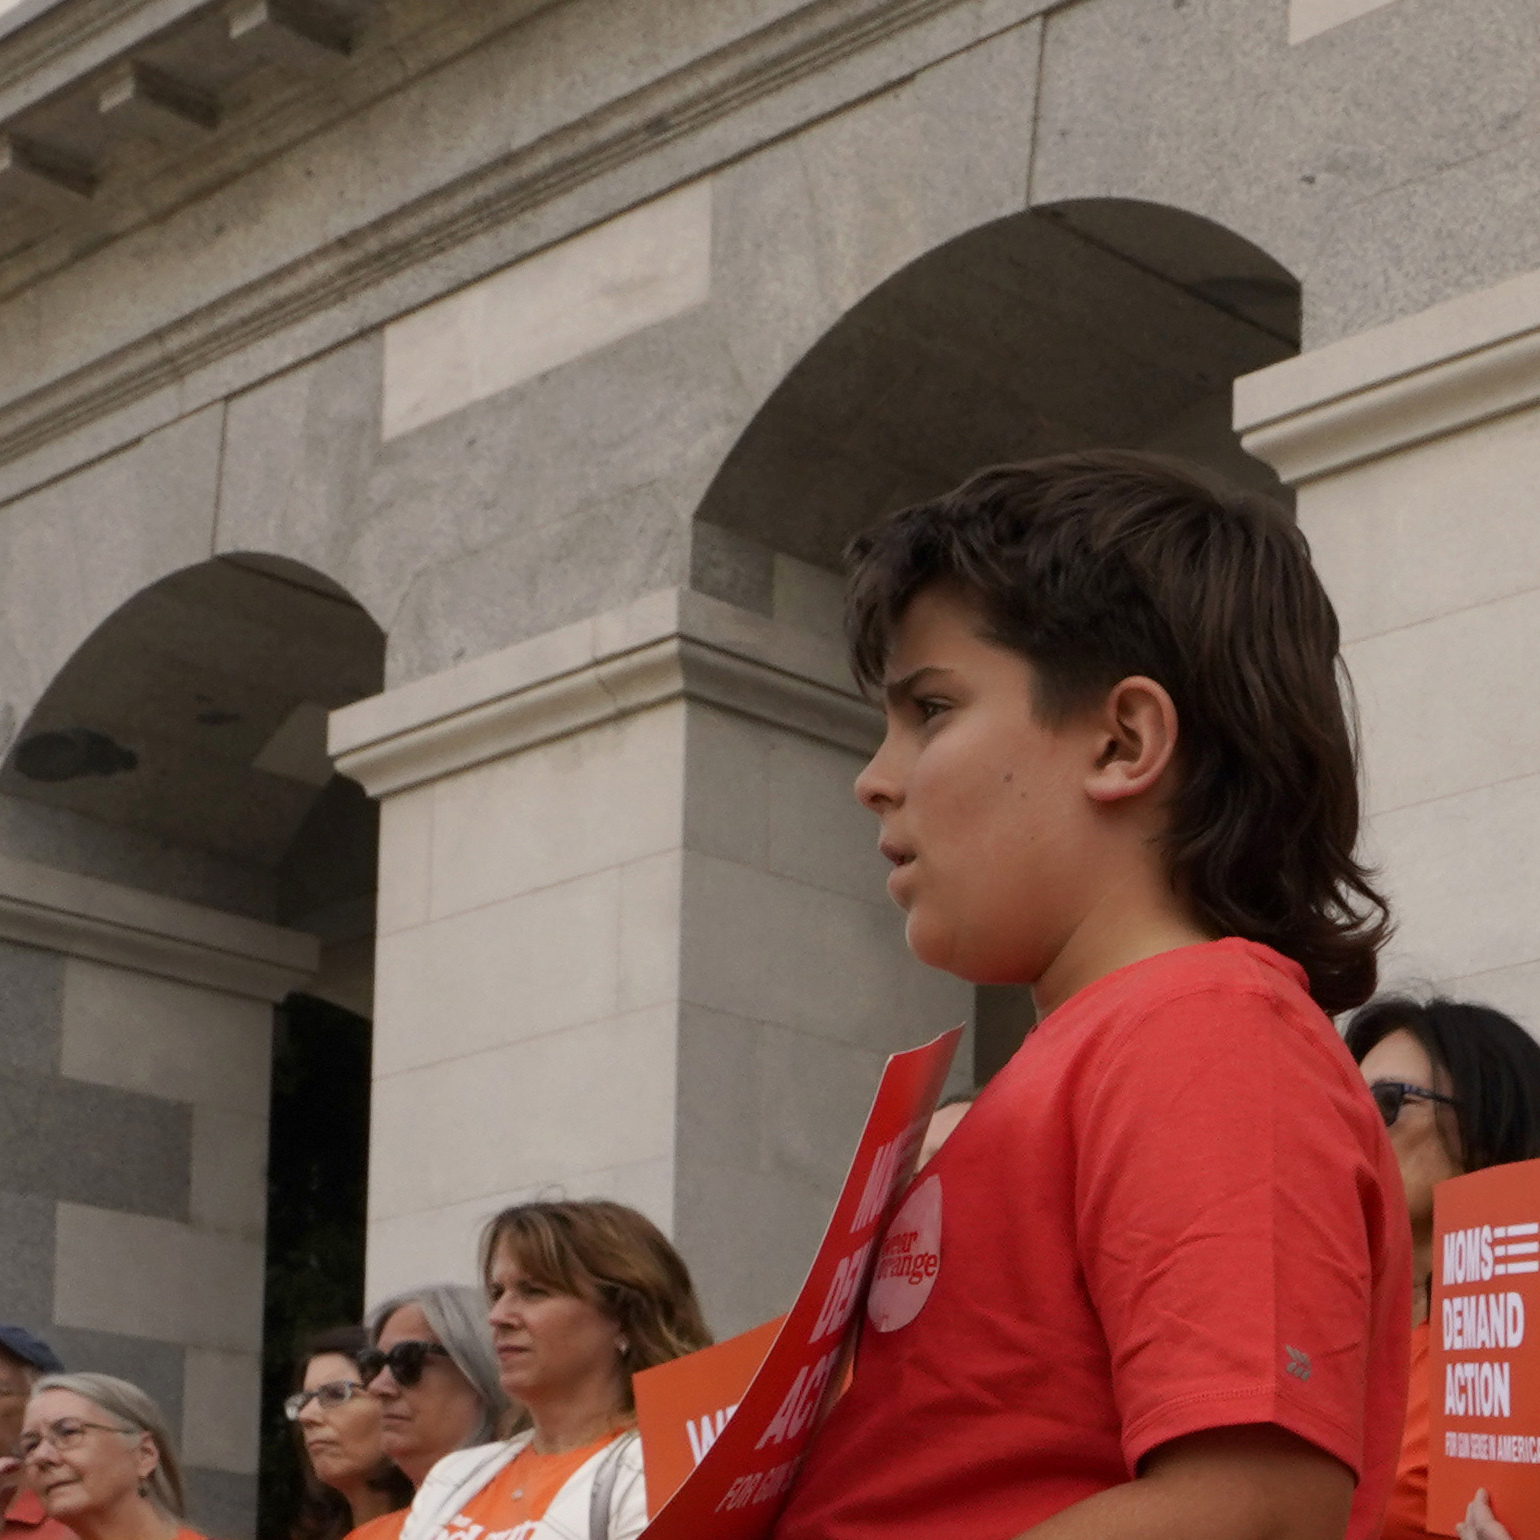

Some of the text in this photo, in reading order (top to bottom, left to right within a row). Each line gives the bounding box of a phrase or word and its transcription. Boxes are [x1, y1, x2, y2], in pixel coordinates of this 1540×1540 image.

[1442, 1225, 1494, 1286] MOMS
[1442, 1292, 1525, 1351] DEMAND
[1444, 1362, 1511, 1418] ACTION
